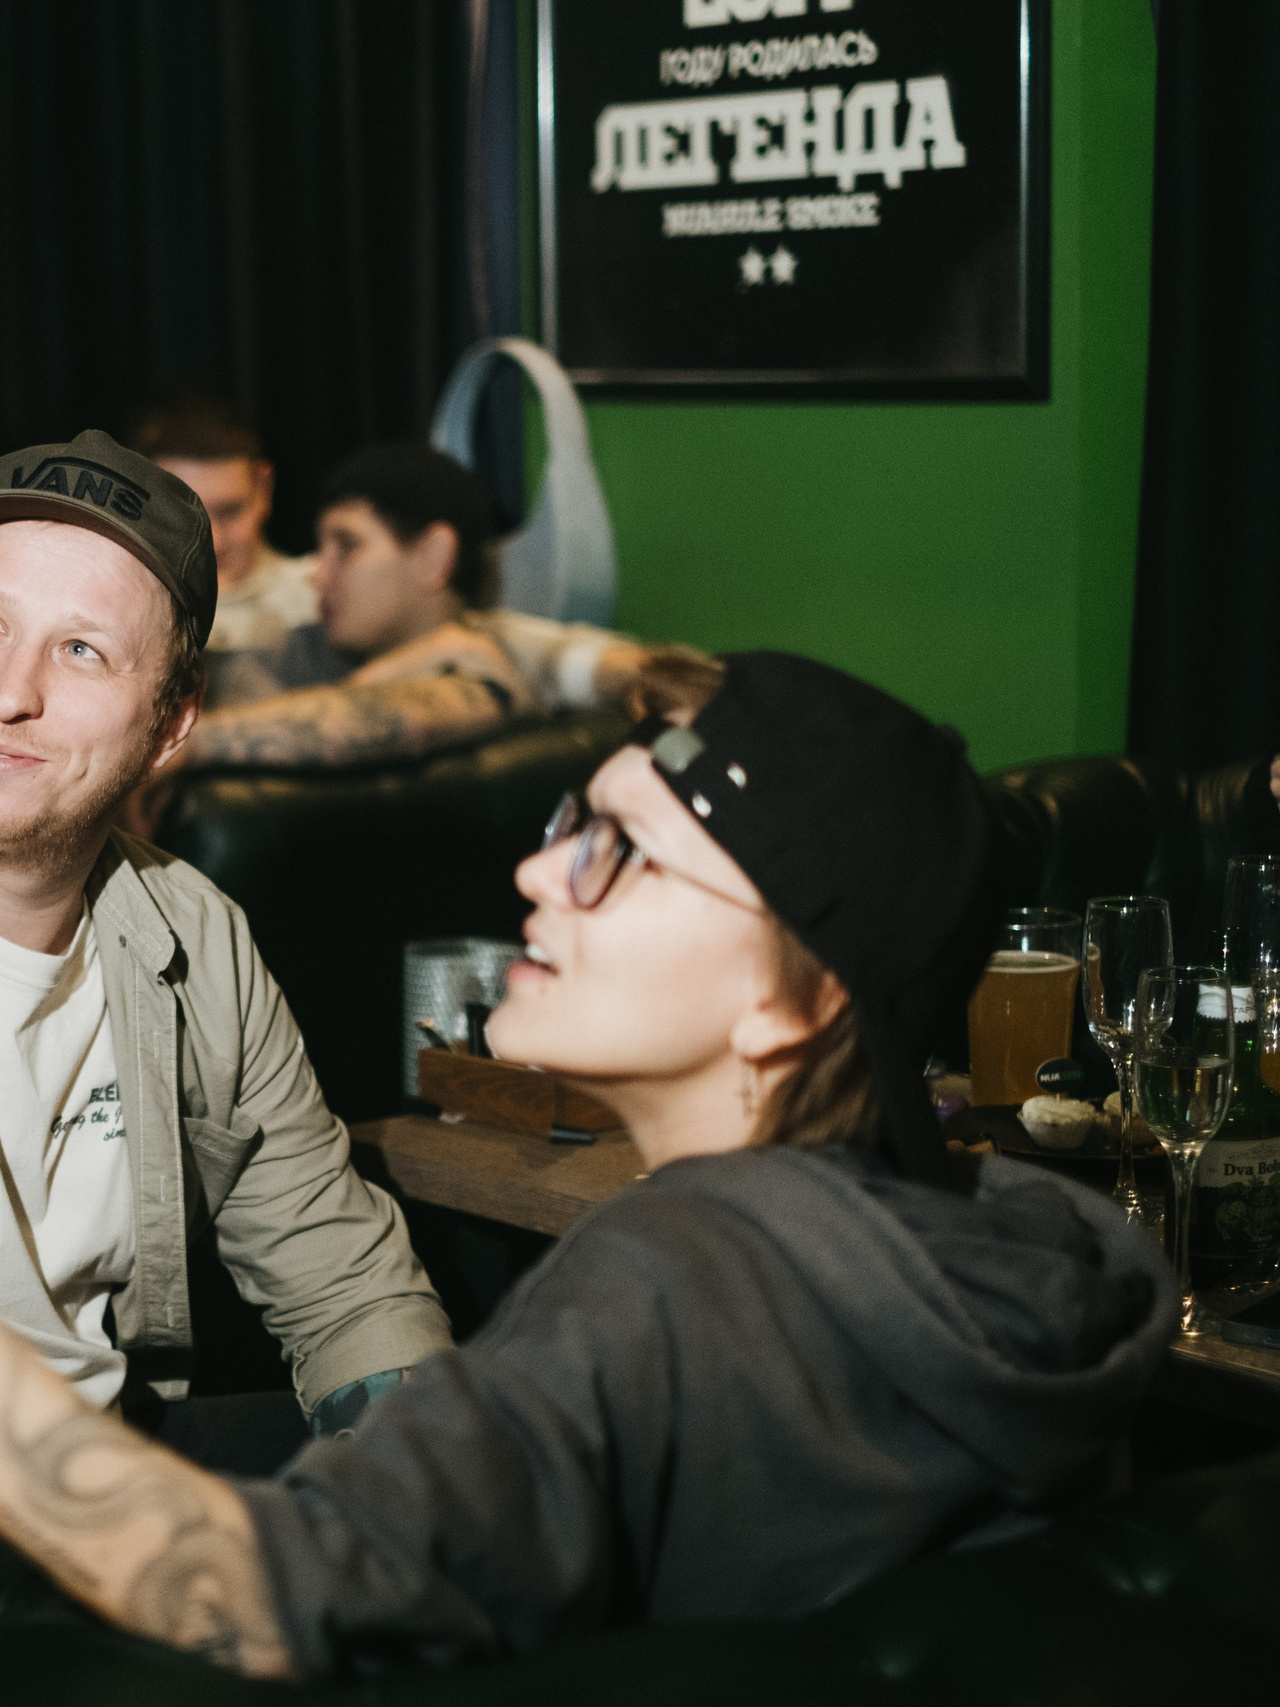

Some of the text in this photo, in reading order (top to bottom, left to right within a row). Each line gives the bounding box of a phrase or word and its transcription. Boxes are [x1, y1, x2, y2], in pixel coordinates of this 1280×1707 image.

[728, 29, 878, 81] РОДИЛАСЬ
[591, 75, 966, 193] ЛЕГЕНДА
[11, 457, 151, 521] VANS
[91, 1107, 109, 1124] the
[1224, 1163, 1254, 1176] Dva
